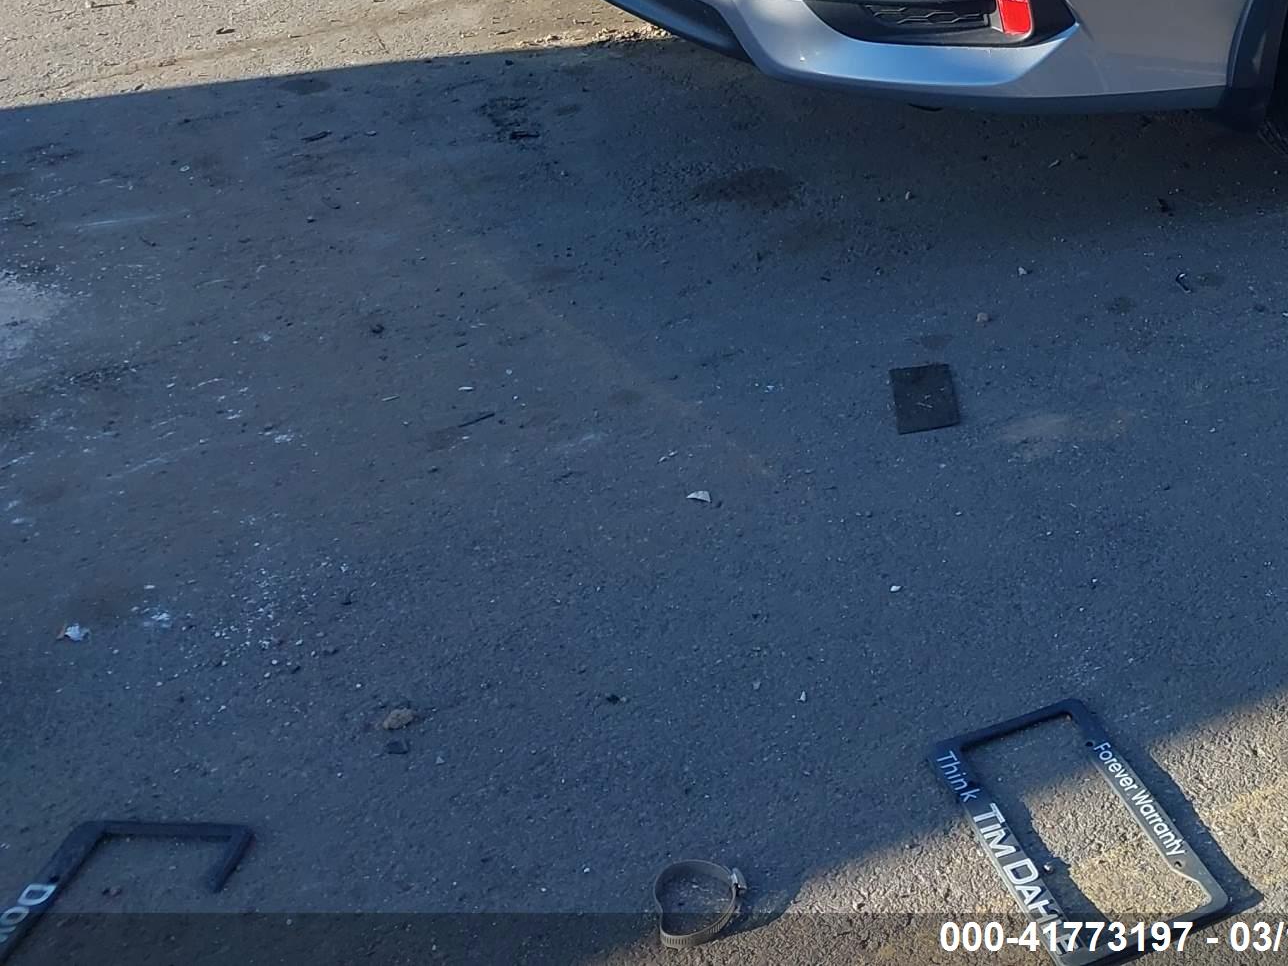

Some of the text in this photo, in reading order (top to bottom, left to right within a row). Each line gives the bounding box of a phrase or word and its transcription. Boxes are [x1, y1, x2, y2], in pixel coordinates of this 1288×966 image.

[937, 751, 980, 802] Think
[973, 802, 1017, 858] TIM
[1094, 742, 1186, 856] Forever Warranty
